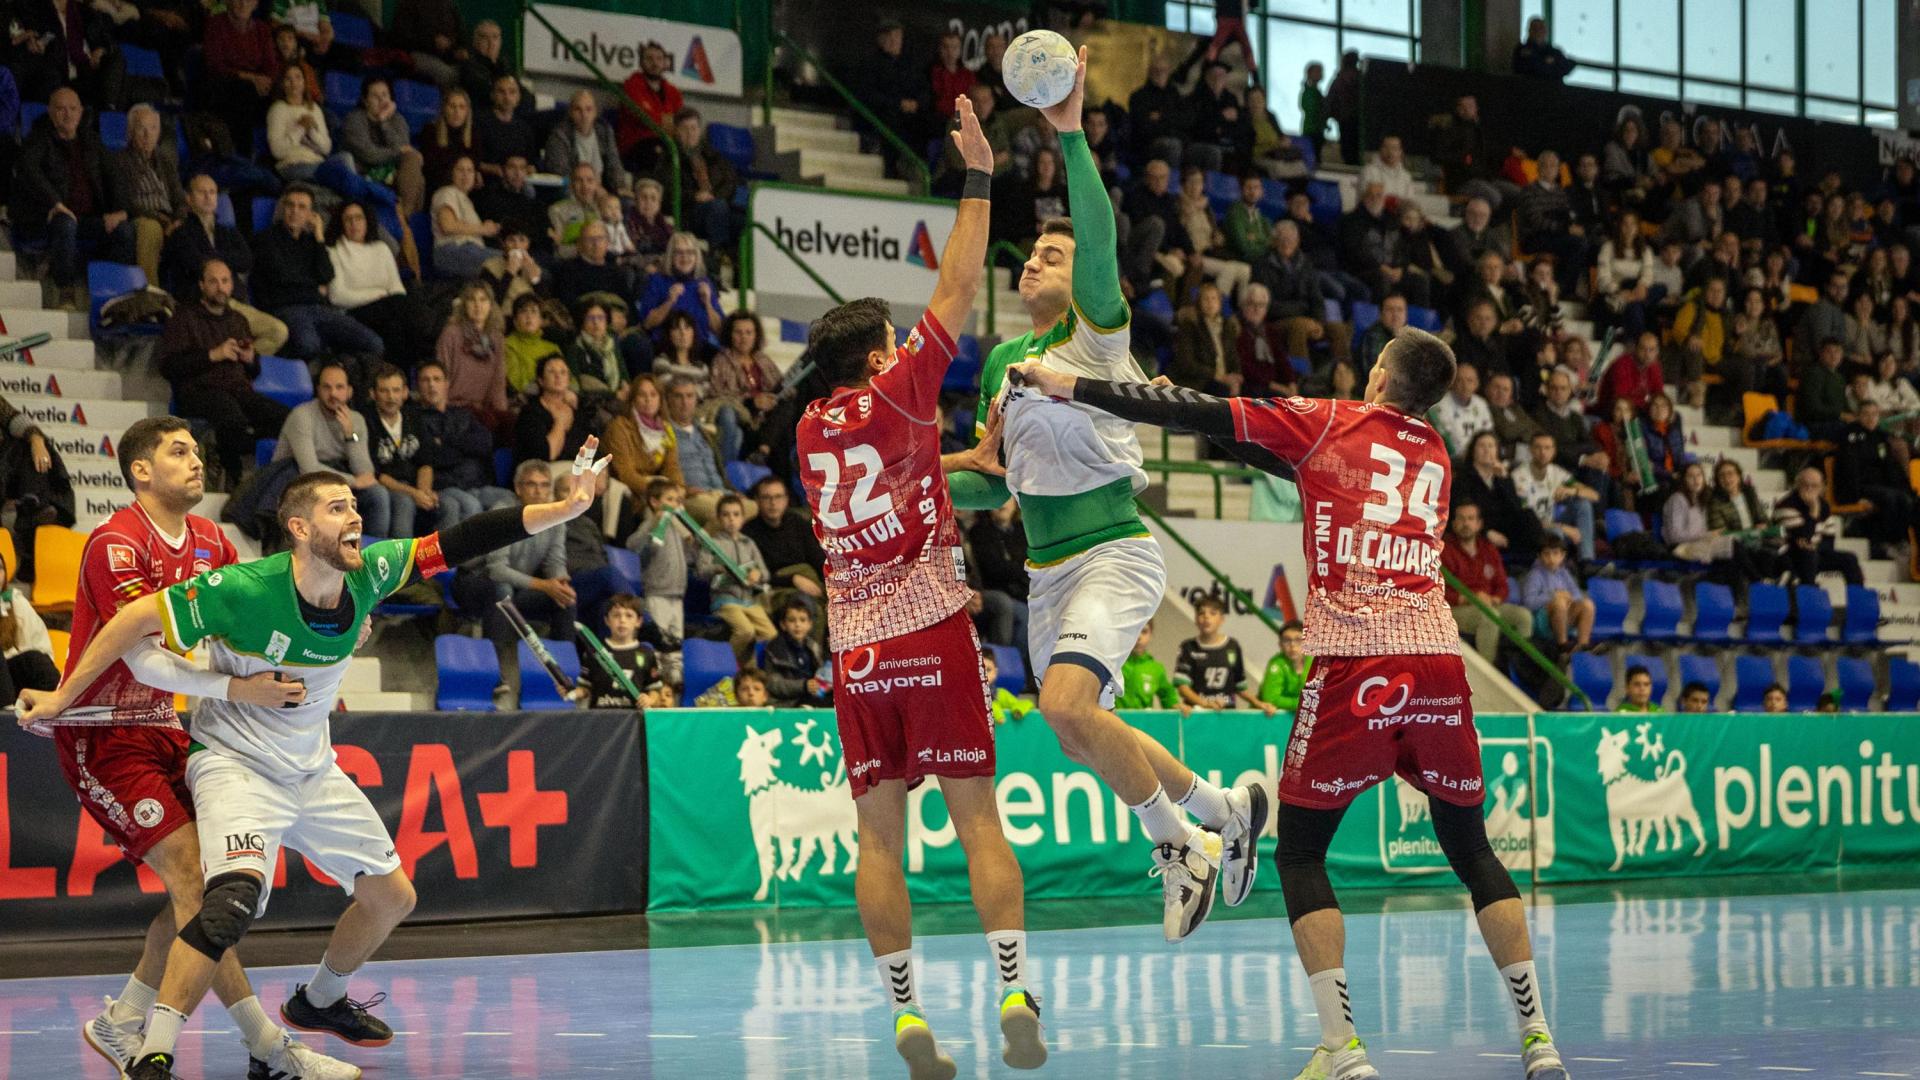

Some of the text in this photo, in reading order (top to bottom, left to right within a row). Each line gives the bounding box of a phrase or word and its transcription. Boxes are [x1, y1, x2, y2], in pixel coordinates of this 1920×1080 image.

[775, 215, 900, 261] helvetia
[1, 376, 42, 394] vetia
[1406, 434, 1427, 445] GEFF
[71, 469, 122, 487] elvetia
[807, 443, 893, 529] 22
[1362, 442, 1445, 538] 34
[1314, 501, 1333, 577] LINLAB
[850, 588, 868, 601] La
[302, 648, 339, 662] Kempa
[879, 654, 942, 670] aniversario
[845, 669, 942, 695] mayoral
[1204, 666, 1228, 689] 43
[1409, 694, 1463, 706] aniversario
[1368, 709, 1462, 731] mayoral
[936, 747, 987, 764] La Rioja
[1442, 775, 1457, 789] La
[224, 832, 266, 861] IMQ
[1388, 835, 1442, 862] plenitu
